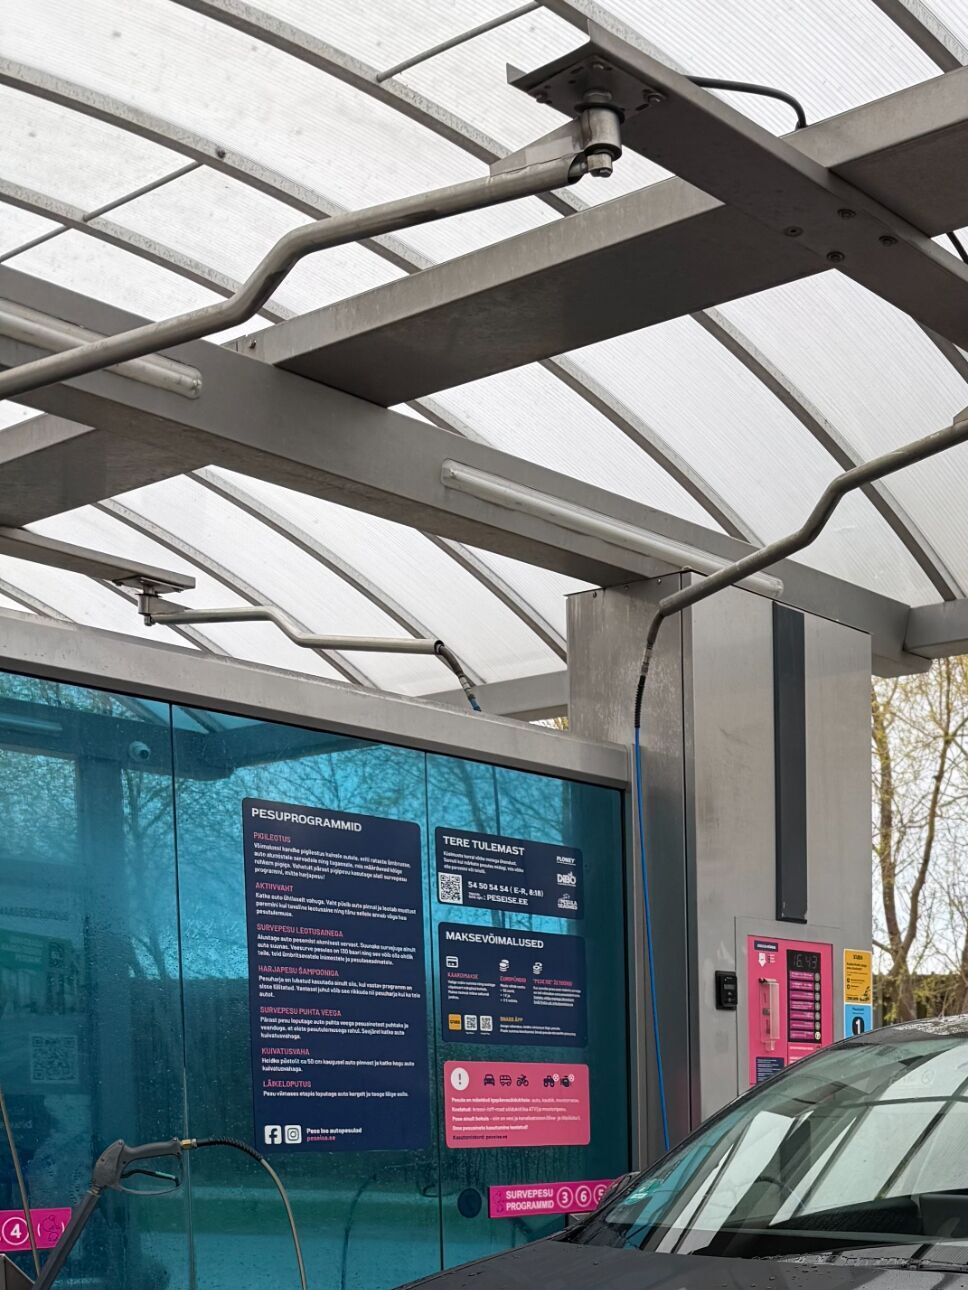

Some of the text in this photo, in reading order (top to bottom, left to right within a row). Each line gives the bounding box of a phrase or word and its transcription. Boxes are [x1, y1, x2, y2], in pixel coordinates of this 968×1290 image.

[252, 807, 362, 832] PESUPROGRAMMID
[443, 835, 525, 856] TERE TULEMAST
[255, 882, 293, 892] AKTIIVVAHT
[468, 881, 477, 889] 54
[479, 882, 488, 890] 50
[486, 894, 529, 905] PESEISE.EE
[257, 923, 295, 934] SURVEPESU
[445, 931, 544, 949] MAKSEVÕIMALUSED
[259, 965, 298, 974] HARJAPESU
[260, 1006, 298, 1015] SURVEPESU
[299, 1008, 320, 1016] PUHTA
[855, 1019, 861, 1035] 1
[262, 1048, 310, 1056] KUIVATUSVAHA
[506, 1189, 554, 1199] SURVEPESU
[562, 1192, 569, 1203] 3
[580, 1191, 587, 1202] 6
[506, 1200, 555, 1211] PROGRAMMID
[10, 1223, 21, 1239] 4
